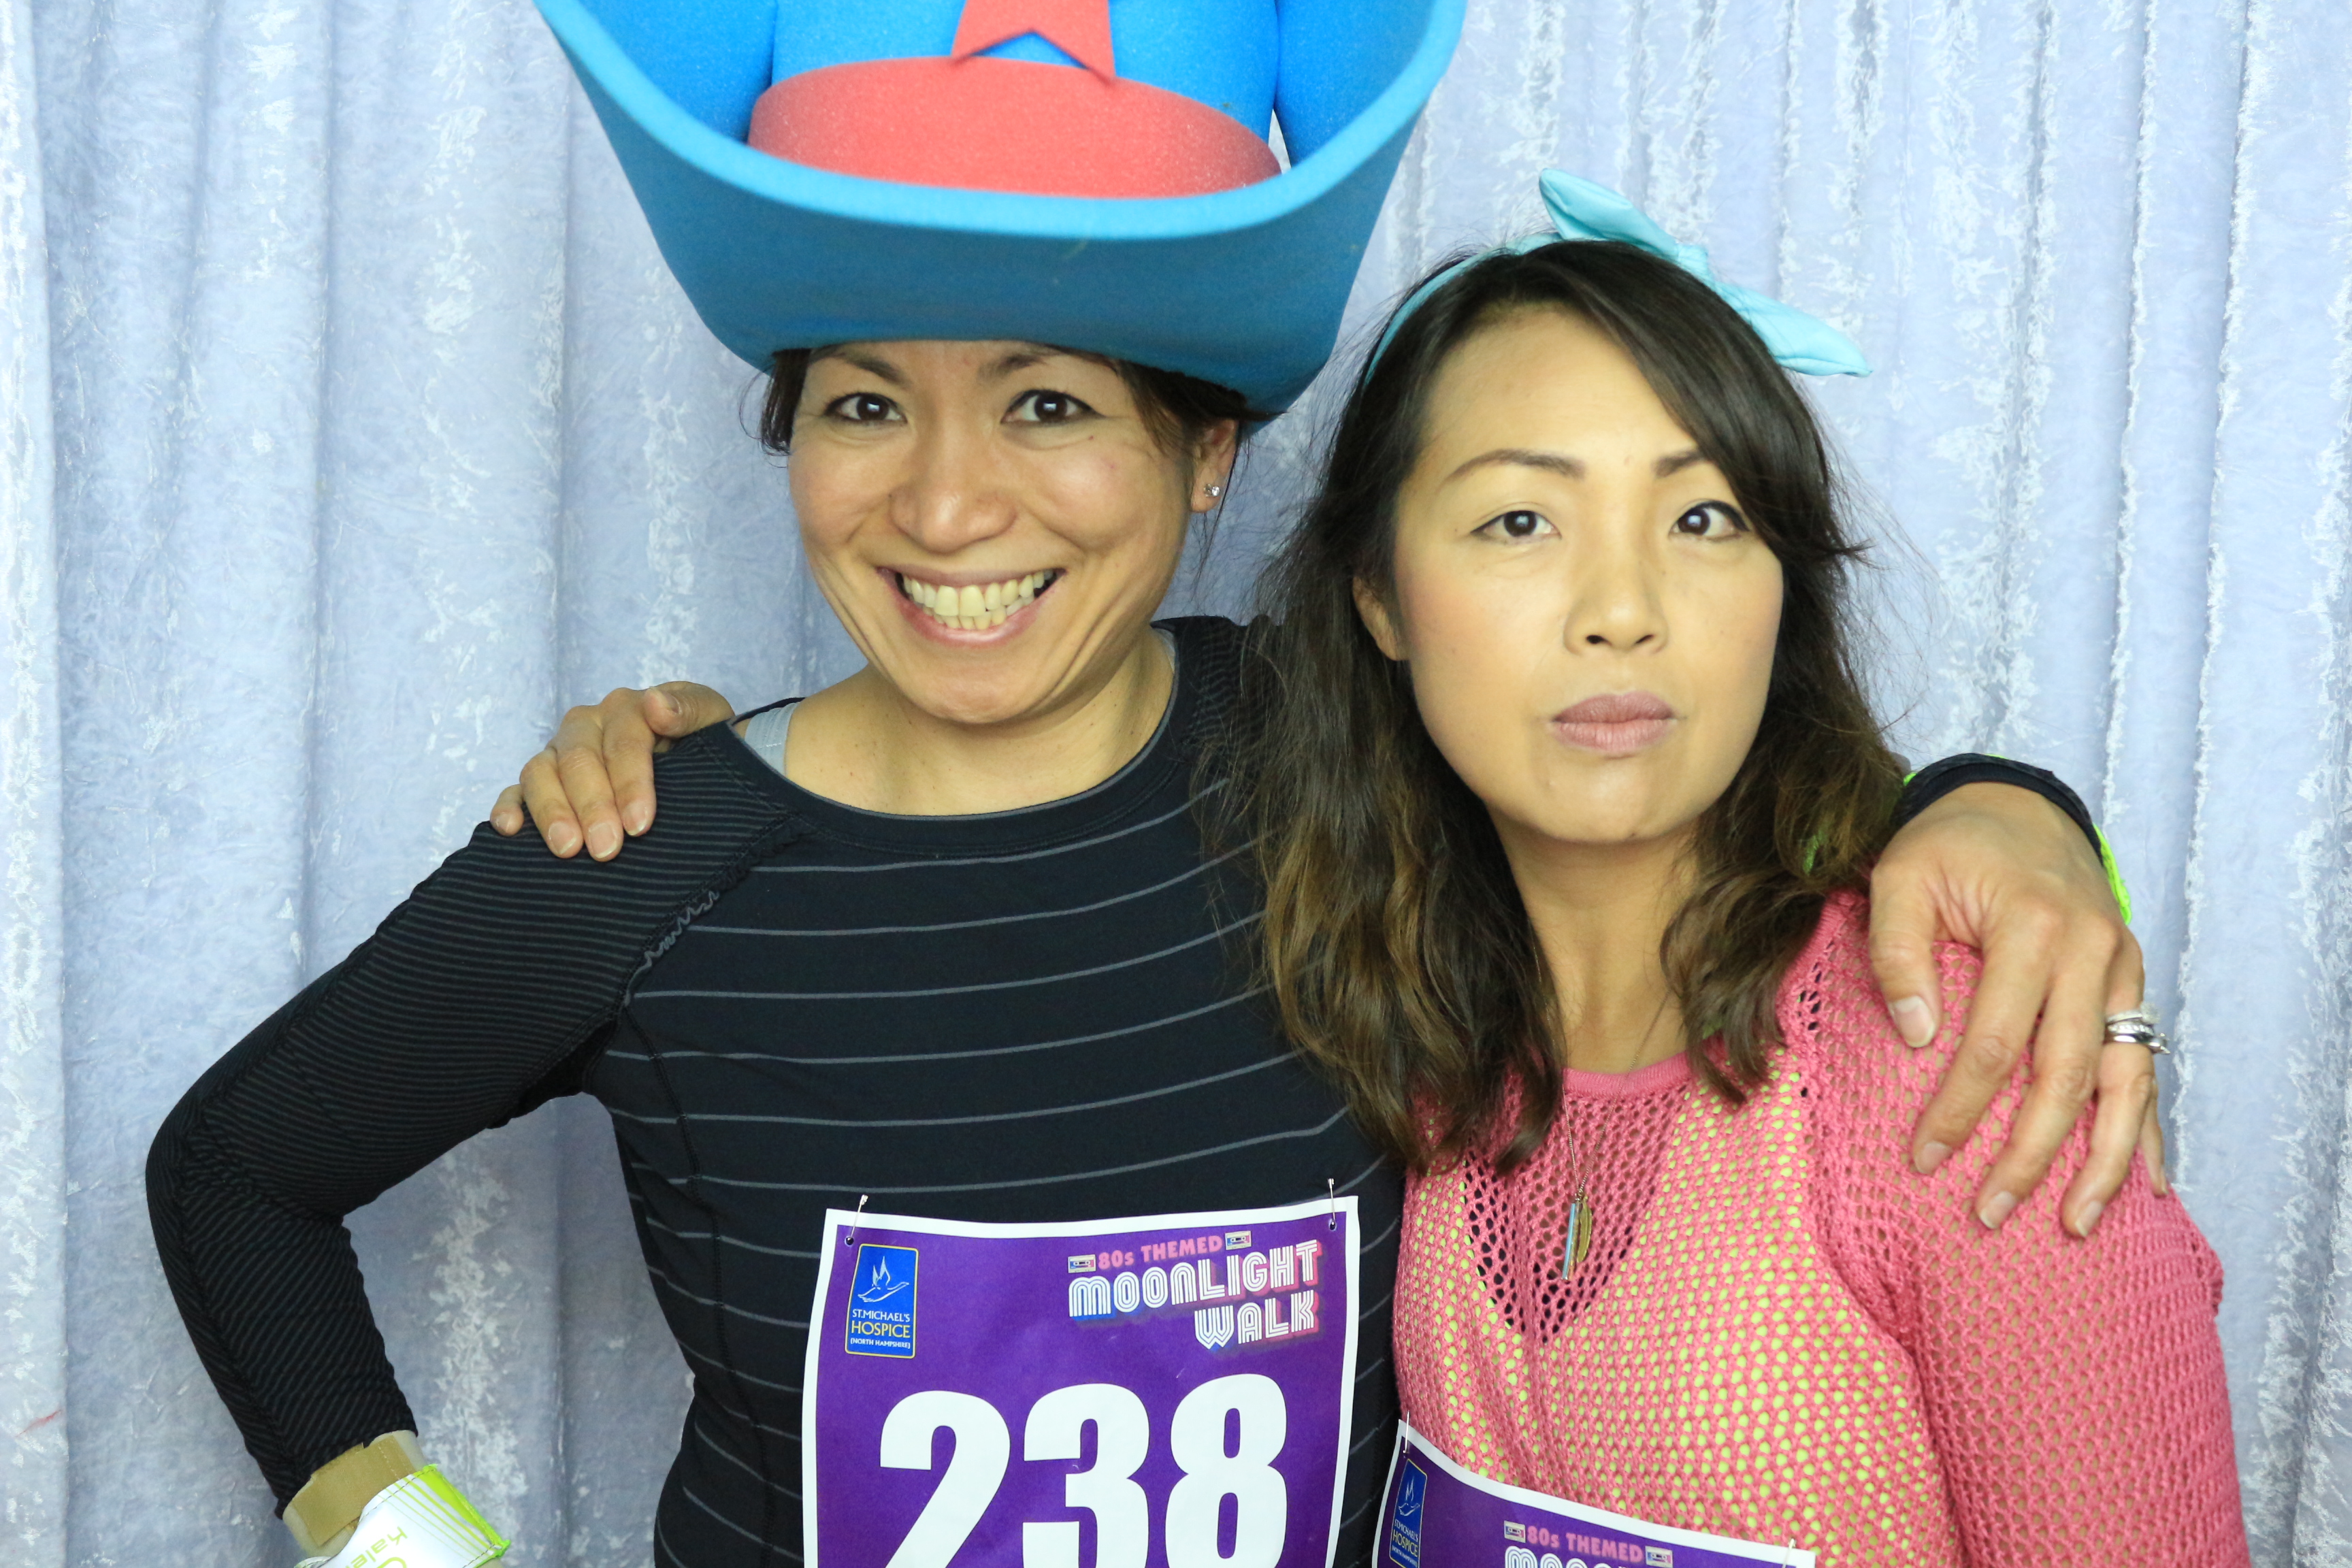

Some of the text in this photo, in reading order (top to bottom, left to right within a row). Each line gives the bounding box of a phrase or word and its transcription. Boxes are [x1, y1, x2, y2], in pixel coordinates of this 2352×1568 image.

[1098, 1235, 1223, 1270] 80s THEMED
[1068, 1239, 1320, 1318] MOONLIGHT
[851, 1320, 911, 1339] HOSPICE
[1194, 1289, 1316, 1350] WALK
[879, 1373, 1288, 1568] 238
[344, 1526, 408, 1568] Kale
[1392, 1529, 1419, 1558] HOSPICE
[1526, 1525, 1560, 1548] 80s
[1565, 1533, 1644, 1563] THEMED
